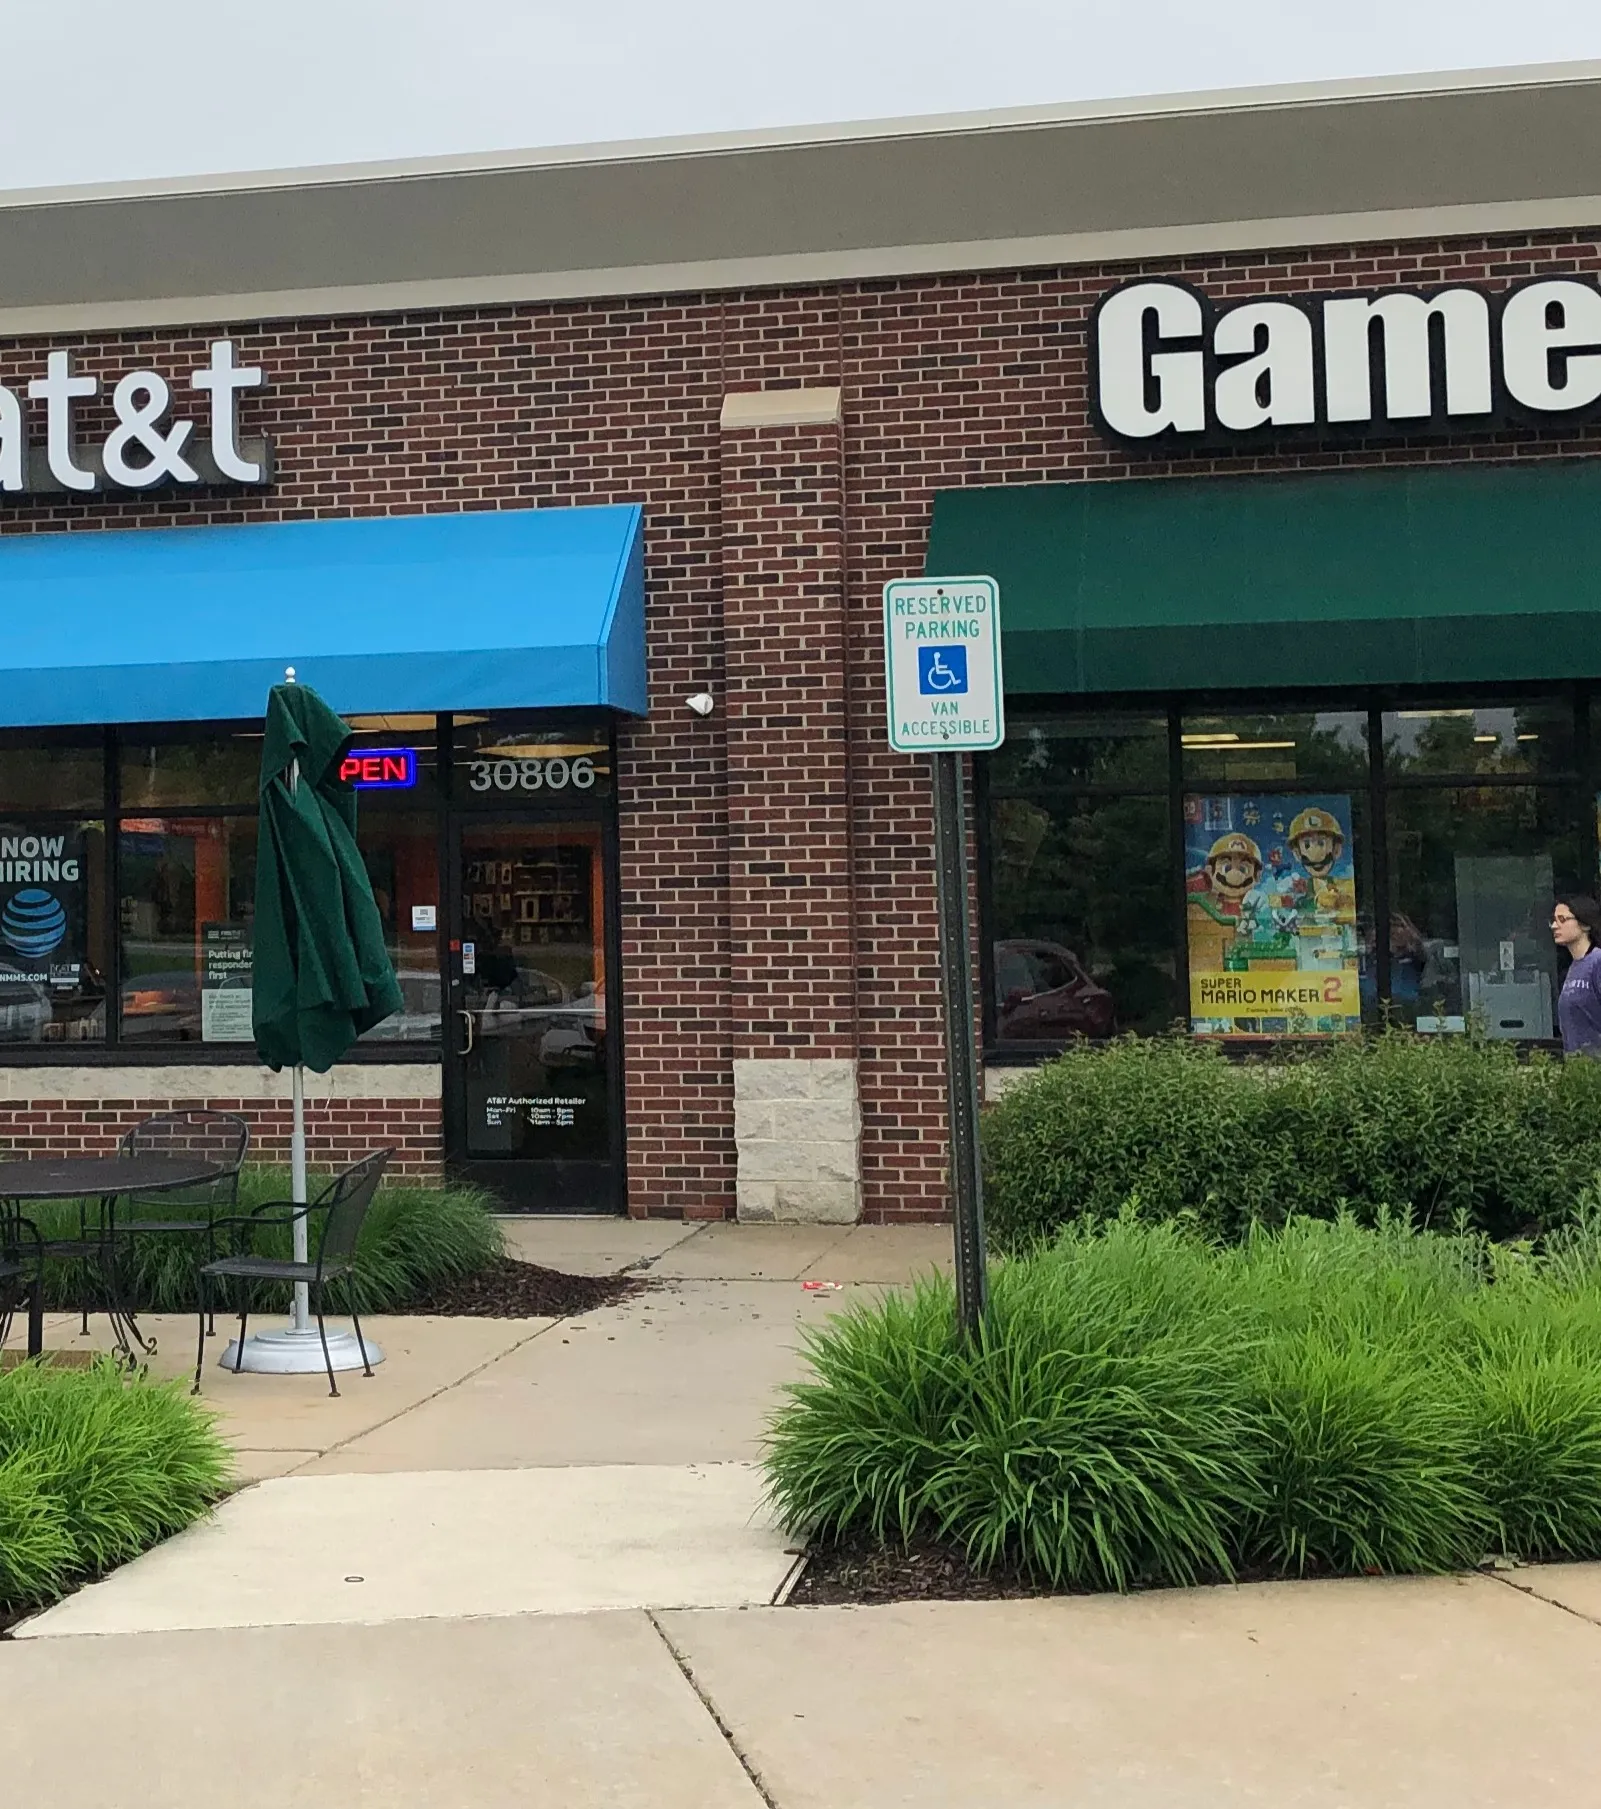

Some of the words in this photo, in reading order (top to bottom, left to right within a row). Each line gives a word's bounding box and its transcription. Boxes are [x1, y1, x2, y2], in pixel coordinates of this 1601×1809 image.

[1098, 280, 1601, 437] Game
[895, 595, 987, 616] RESERVED
[905, 619, 980, 639] PARKING
[931, 701, 959, 716] VAN
[901, 719, 990, 737] ACCESSIBLE
[340, 757, 407, 782] PEN
[469, 757, 596, 791] 30806
[1, 836, 65, 859] NOW
[208, 949, 241, 960] Putting
[242, 949, 254, 959] fir
[208, 959, 254, 970] responder
[208, 971, 228, 980] first
[1200, 978, 1242, 989] SUPER
[1201, 989, 1257, 1004] MARIO
[1261, 988, 1319, 1003] MAKER
[1323, 977, 1343, 1003] 2
[486, 1097, 507, 1105] AT&T
[508, 1097, 554, 1105] Authorized
[554, 1097, 587, 1105] Retailer
